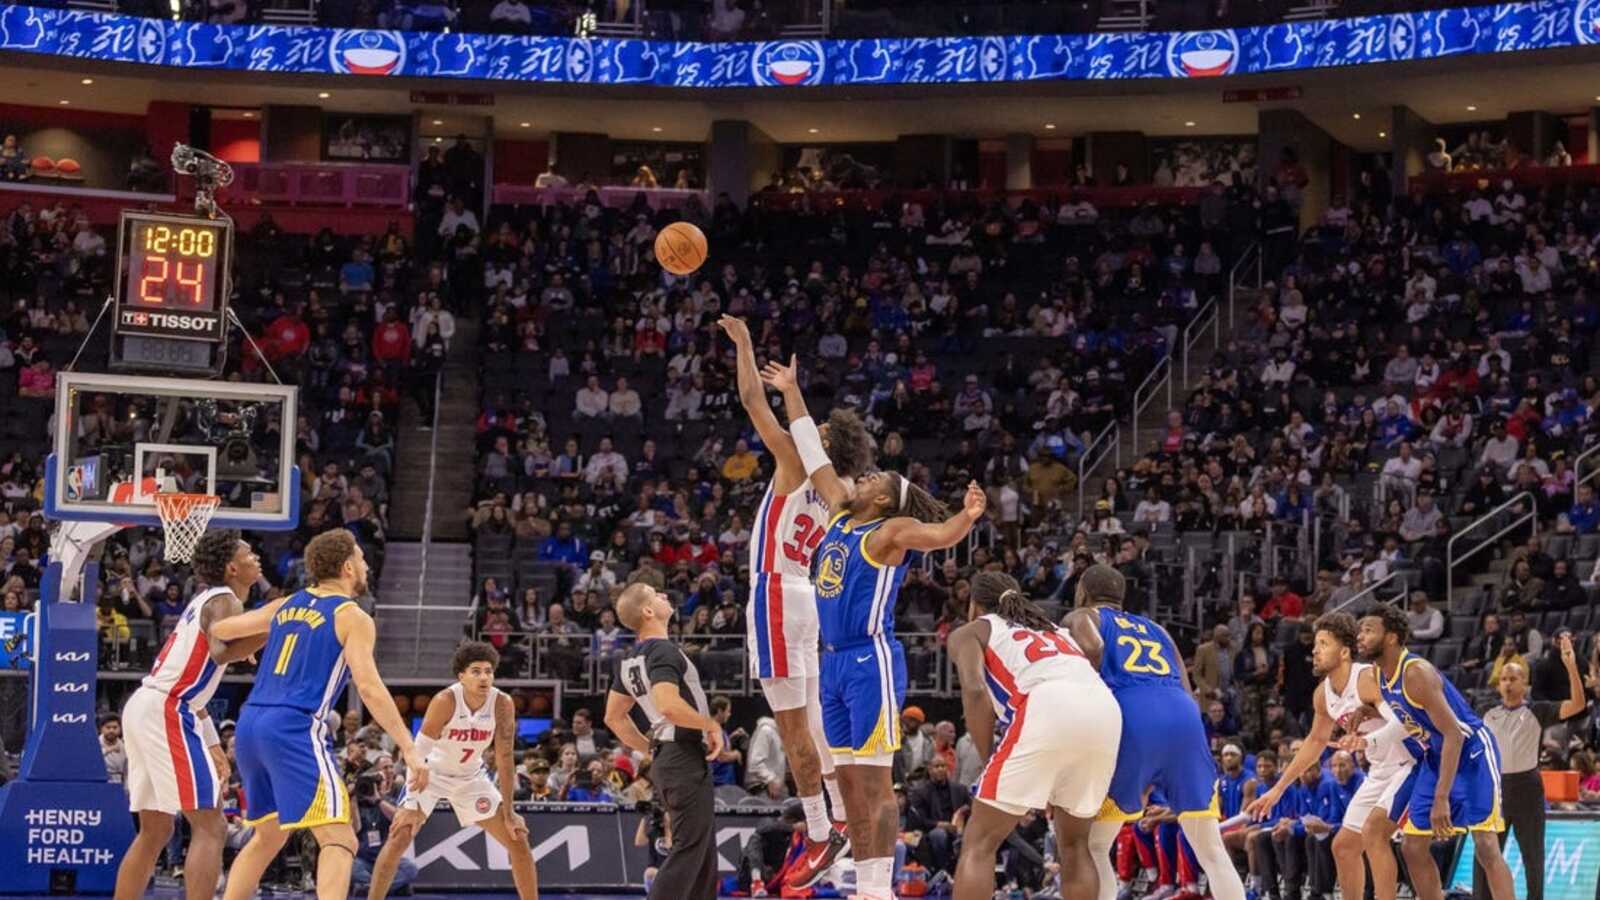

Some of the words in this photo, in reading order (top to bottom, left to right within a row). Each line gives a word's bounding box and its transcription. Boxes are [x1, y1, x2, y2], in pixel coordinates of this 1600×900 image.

[146, 226, 214, 257] 12:00
[140, 256, 203, 304] 24
[150, 313, 217, 331] TISSOT
[273, 632, 299, 675] 11
[1117, 635, 1170, 676] 23
[459, 748, 475, 764] 7
[25, 808, 102, 827] HENRY
[28, 827, 85, 845] FORD
[27, 847, 115, 865] HEALTH
